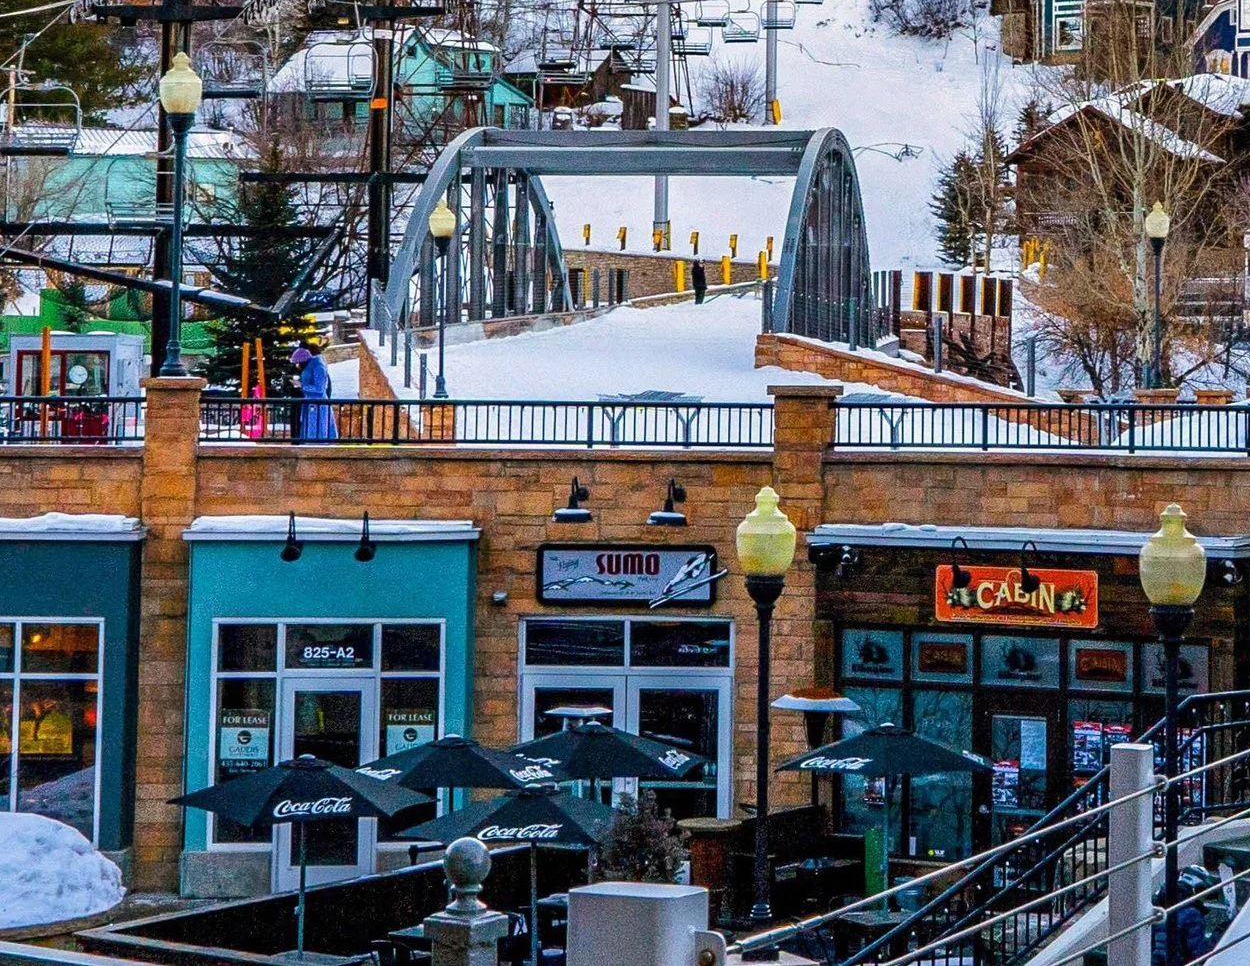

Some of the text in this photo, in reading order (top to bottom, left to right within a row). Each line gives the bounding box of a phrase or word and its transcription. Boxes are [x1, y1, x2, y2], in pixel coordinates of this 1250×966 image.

[595, 553, 661, 575] SUMO
[303, 646, 355, 659] 825-A2
[222, 716, 267, 724] FOR LEASE
[388, 713, 433, 722] FOR LEASE
[273, 797, 353, 818] Coca-Cola
[477, 824, 563, 841] Coca-Cola
